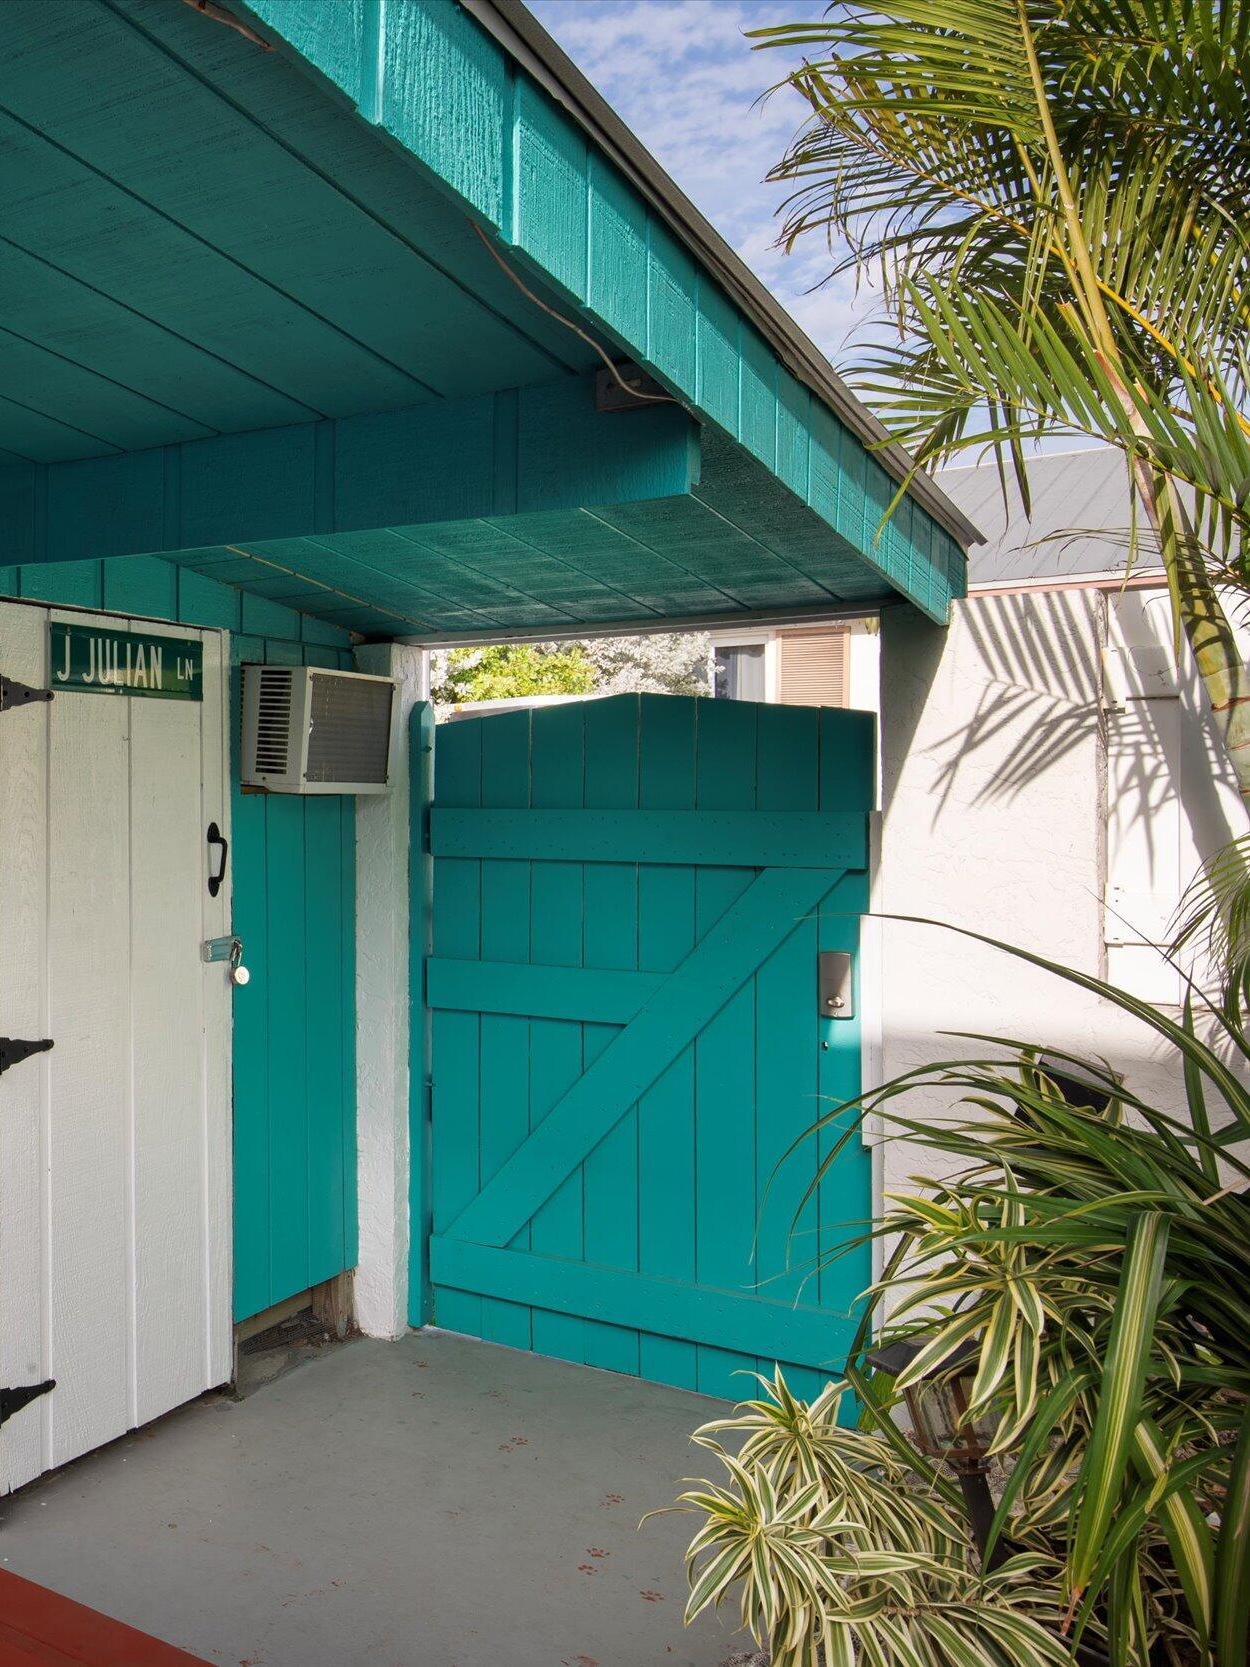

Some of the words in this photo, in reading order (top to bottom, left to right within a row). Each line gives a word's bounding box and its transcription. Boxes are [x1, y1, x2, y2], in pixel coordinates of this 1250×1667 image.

[56, 635, 71, 682] J
[82, 637, 162, 690] JULIAN
[177, 656, 193, 681] LN
